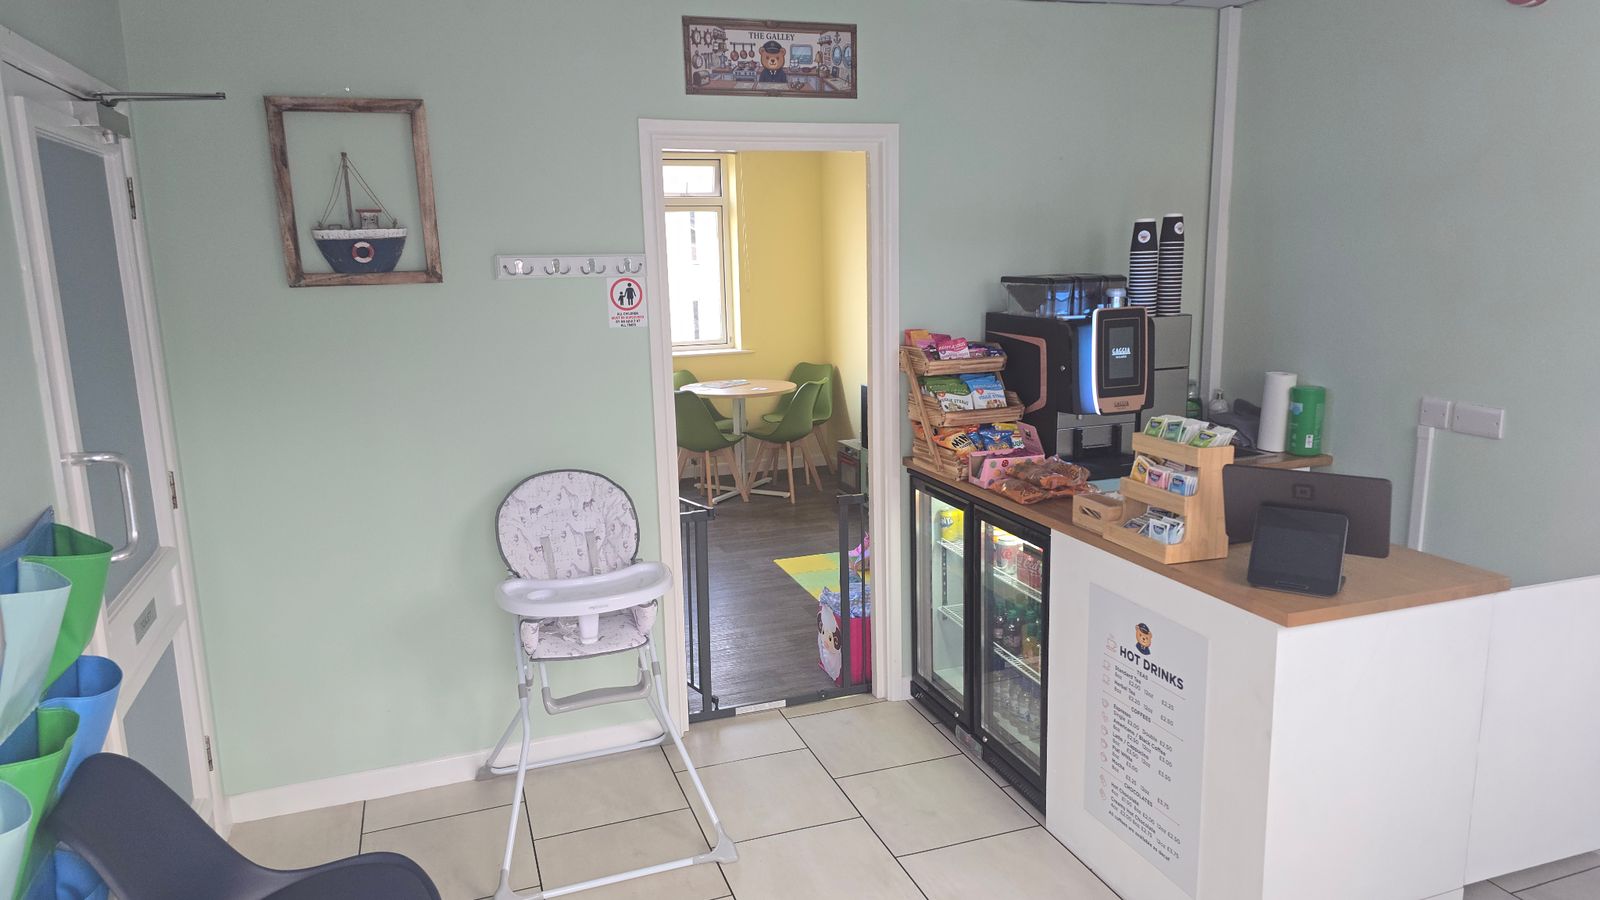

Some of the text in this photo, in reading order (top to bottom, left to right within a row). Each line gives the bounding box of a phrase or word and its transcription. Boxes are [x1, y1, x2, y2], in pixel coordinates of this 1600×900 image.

[766, 33, 795, 41] GALLEY
[1115, 665, 1132, 679] Standard
[1120, 646, 1183, 690] HOT DRINKS
[1137, 670, 1148, 680] TEAS
[1113, 703, 1130, 718] Espresso
[1131, 706, 1150, 722] COFFEES
[1113, 718, 1134, 735] Americano
[1138, 735, 1150, 746] Black
[1151, 743, 1166, 756] Coffee
[1113, 732, 1122, 742] Latte
[1121, 751, 1132, 762] White
[1112, 758, 1124, 770] Mocha
[1119, 788, 1138, 805] Chocolate
[1124, 782, 1152, 807] CHOCOLATES
[1110, 796, 1125, 811] Creamy
[1134, 814, 1155, 833] Chocolate
[1158, 849, 1169, 861] decaf
